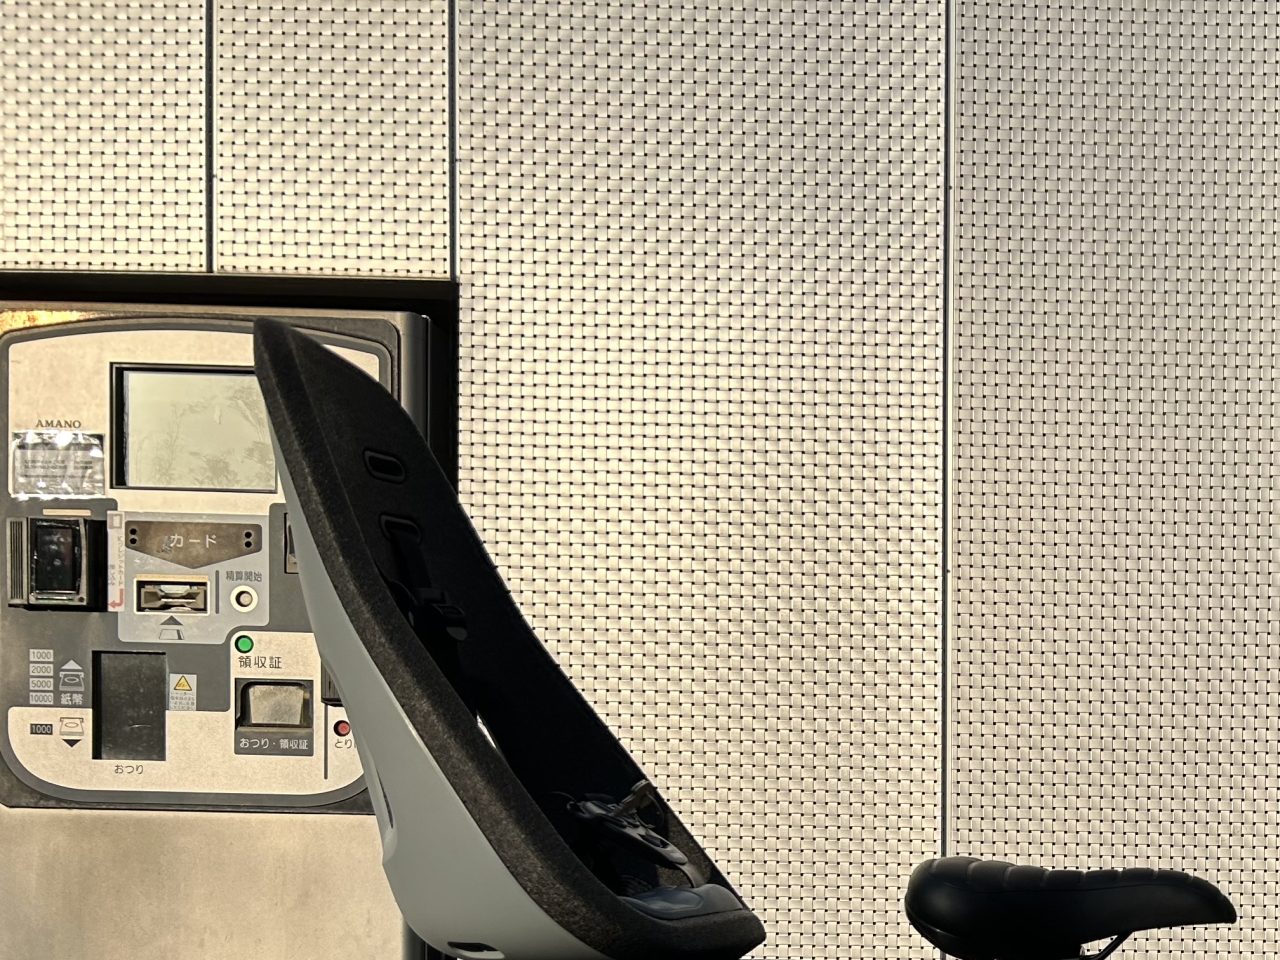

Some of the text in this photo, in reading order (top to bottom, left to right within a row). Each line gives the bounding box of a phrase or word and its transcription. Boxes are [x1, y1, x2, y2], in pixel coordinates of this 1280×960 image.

[35, 419, 82, 429] AMANO
[169, 533, 217, 549] カード
[225, 570, 263, 583] 精算開始
[32, 651, 52, 660] 1000
[238, 655, 283, 669] 領収証
[31, 665, 52, 674] 2000
[31, 680, 52, 689] 5000
[30, 692, 53, 703] 10000
[31, 725, 52, 734] 1000
[114, 764, 144, 775] おつり
